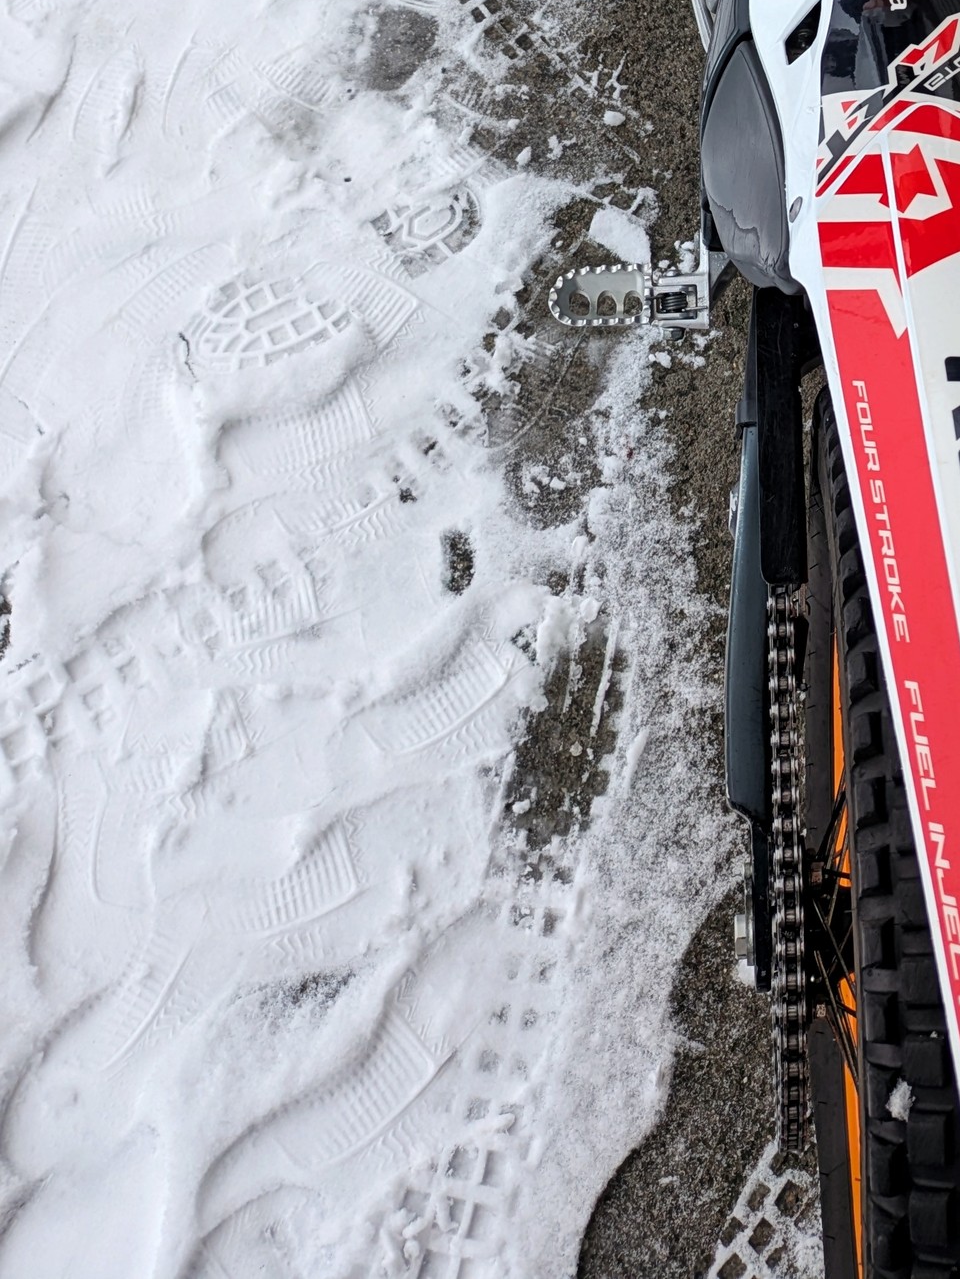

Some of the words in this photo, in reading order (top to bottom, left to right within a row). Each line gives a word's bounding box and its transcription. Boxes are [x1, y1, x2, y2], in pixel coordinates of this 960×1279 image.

[852, 380, 882, 471] FOUR
[869, 479, 910, 643] STROKE
[904, 680, 936, 811] FUEL
